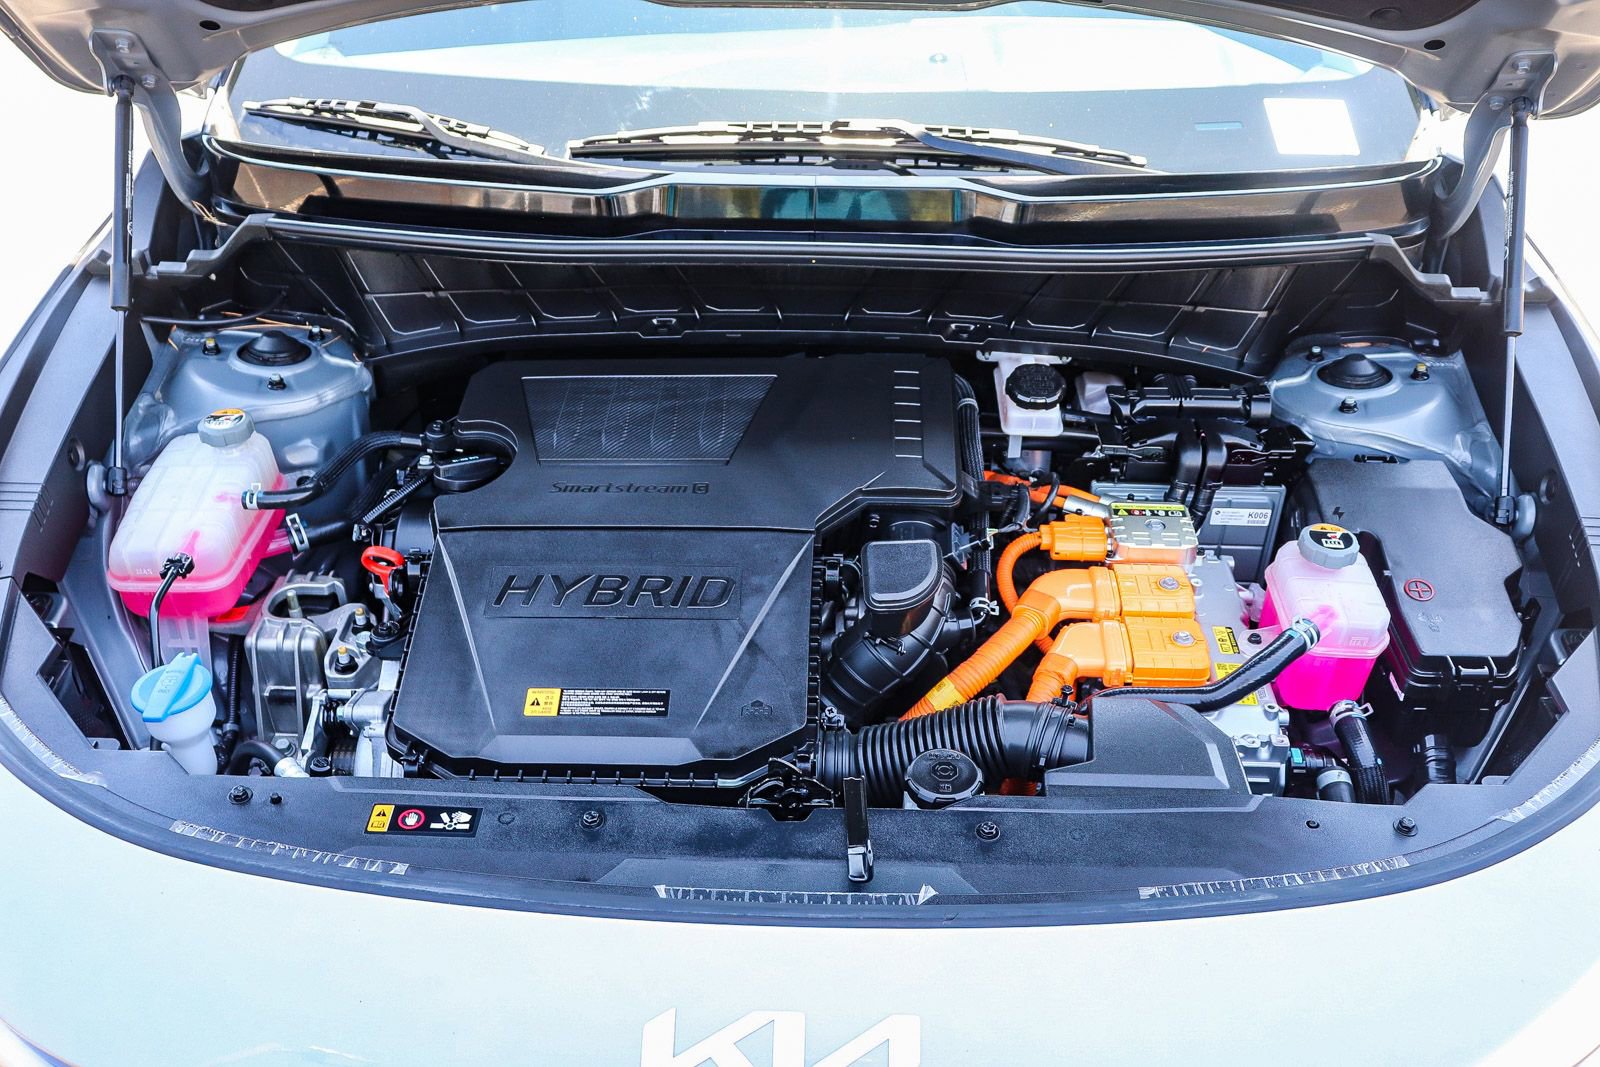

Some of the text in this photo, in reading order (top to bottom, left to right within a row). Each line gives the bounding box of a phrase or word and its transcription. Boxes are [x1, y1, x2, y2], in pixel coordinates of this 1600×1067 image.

[549, 480, 689, 494] Smartstream
[1247, 511, 1269, 520] K006
[491, 574, 736, 609] HYBRID
